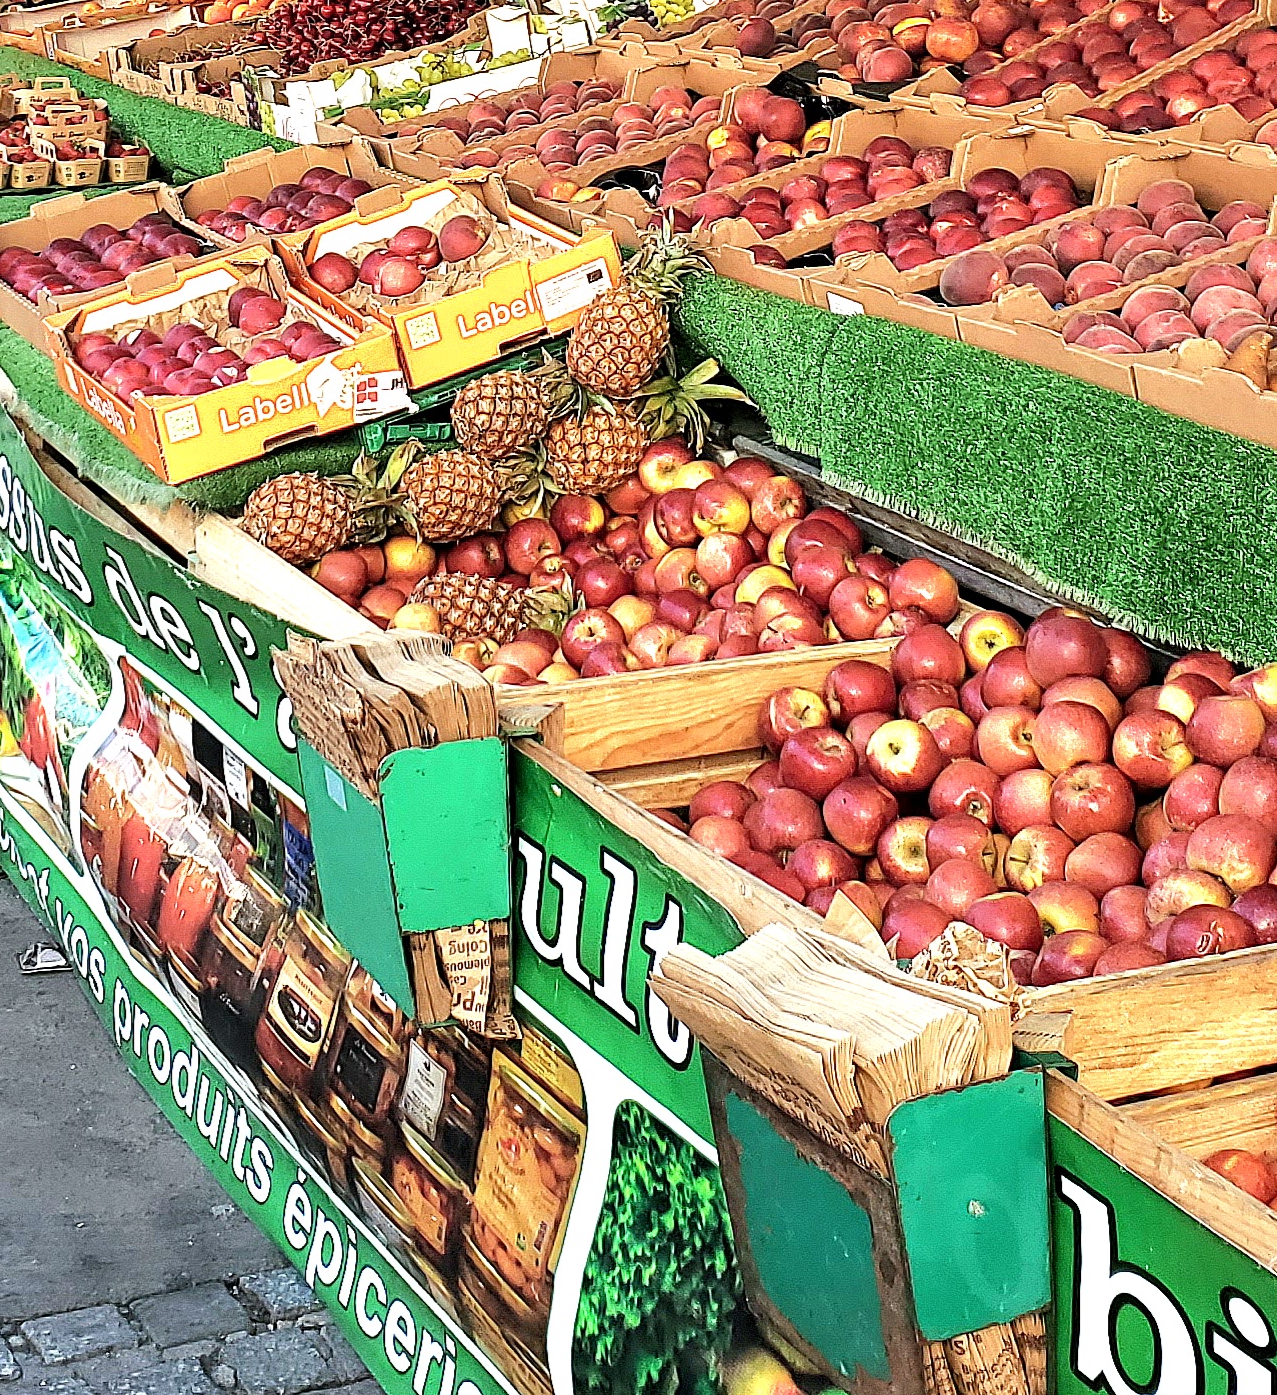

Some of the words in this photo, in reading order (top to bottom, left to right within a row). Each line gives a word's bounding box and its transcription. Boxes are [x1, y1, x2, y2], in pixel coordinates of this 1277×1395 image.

[219, 382, 311, 434] Labell
[104, 547, 200, 672] de
[56, 897, 106, 1004] vos
[113, 977, 274, 1204] produits
